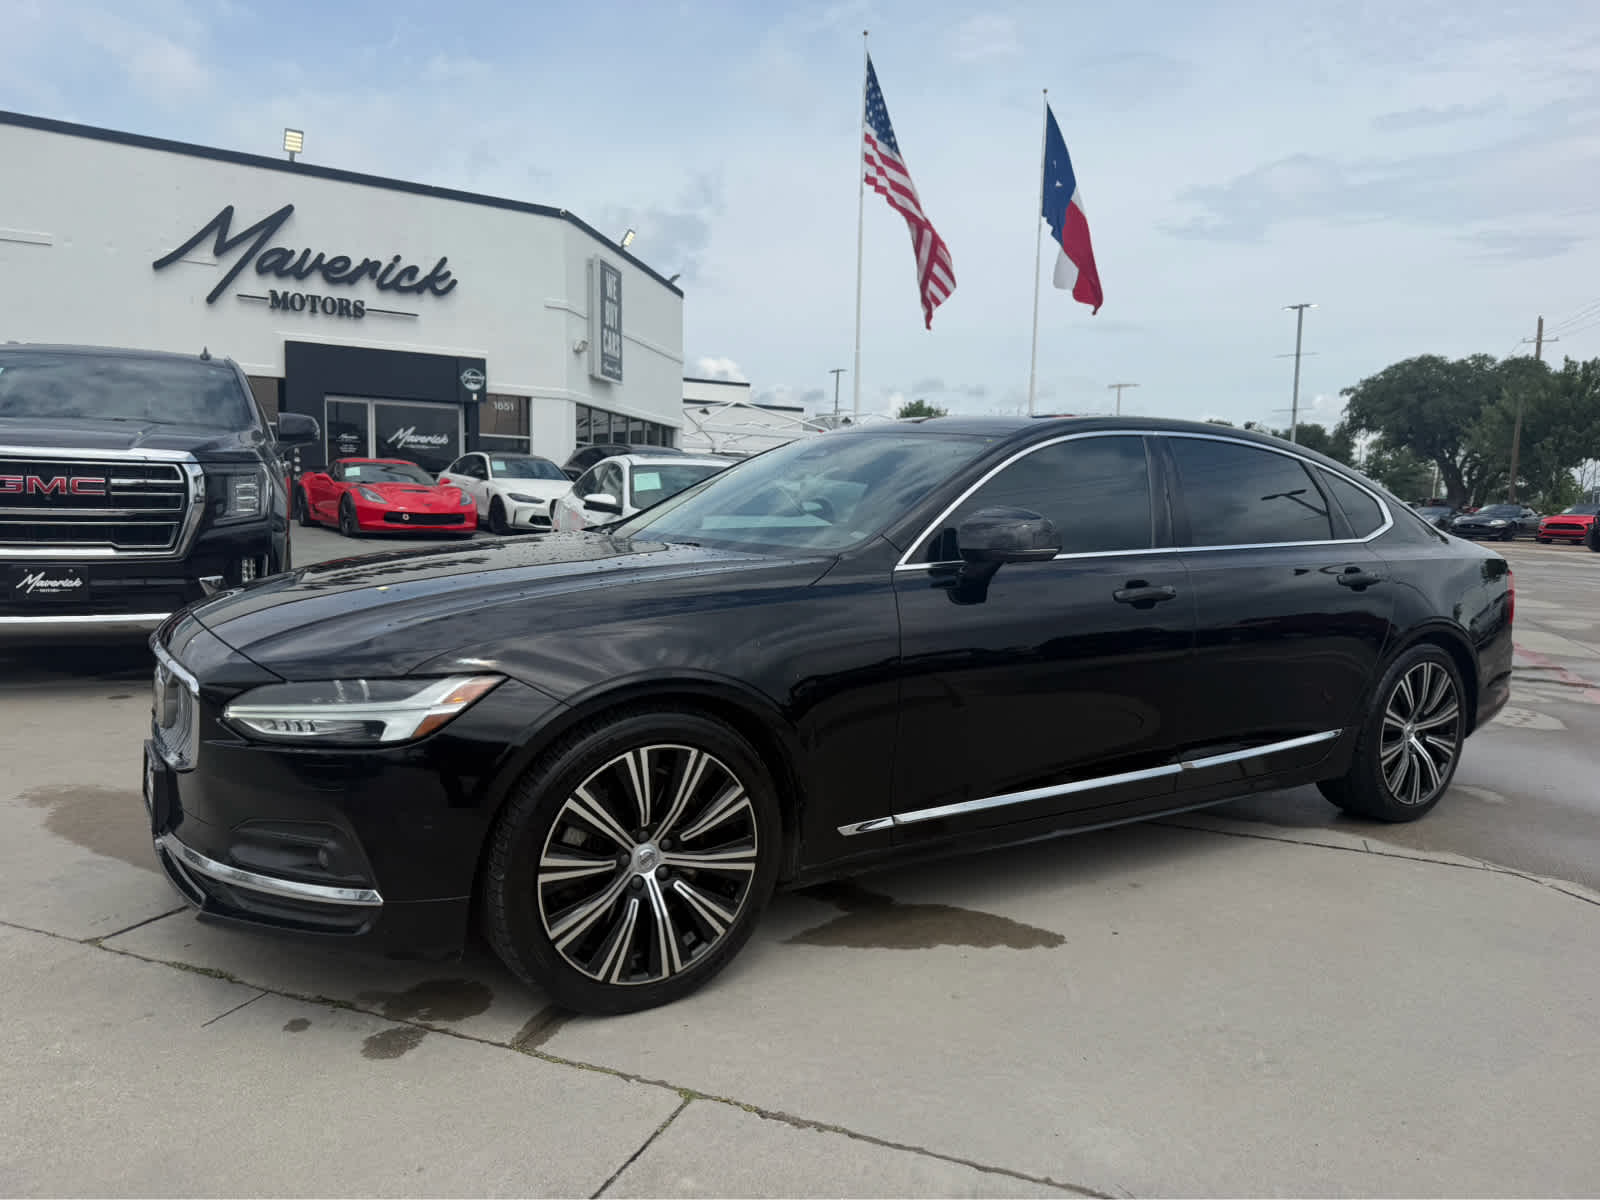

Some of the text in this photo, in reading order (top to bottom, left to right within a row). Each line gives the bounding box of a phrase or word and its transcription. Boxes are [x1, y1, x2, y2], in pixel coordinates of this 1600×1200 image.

[153, 204, 457, 304] Maverick
[269, 290, 366, 319] MOTORS
[387, 426, 449, 449] Maverick
[0, 475, 105, 496] GMC
[15, 571, 83, 594] Maverick
